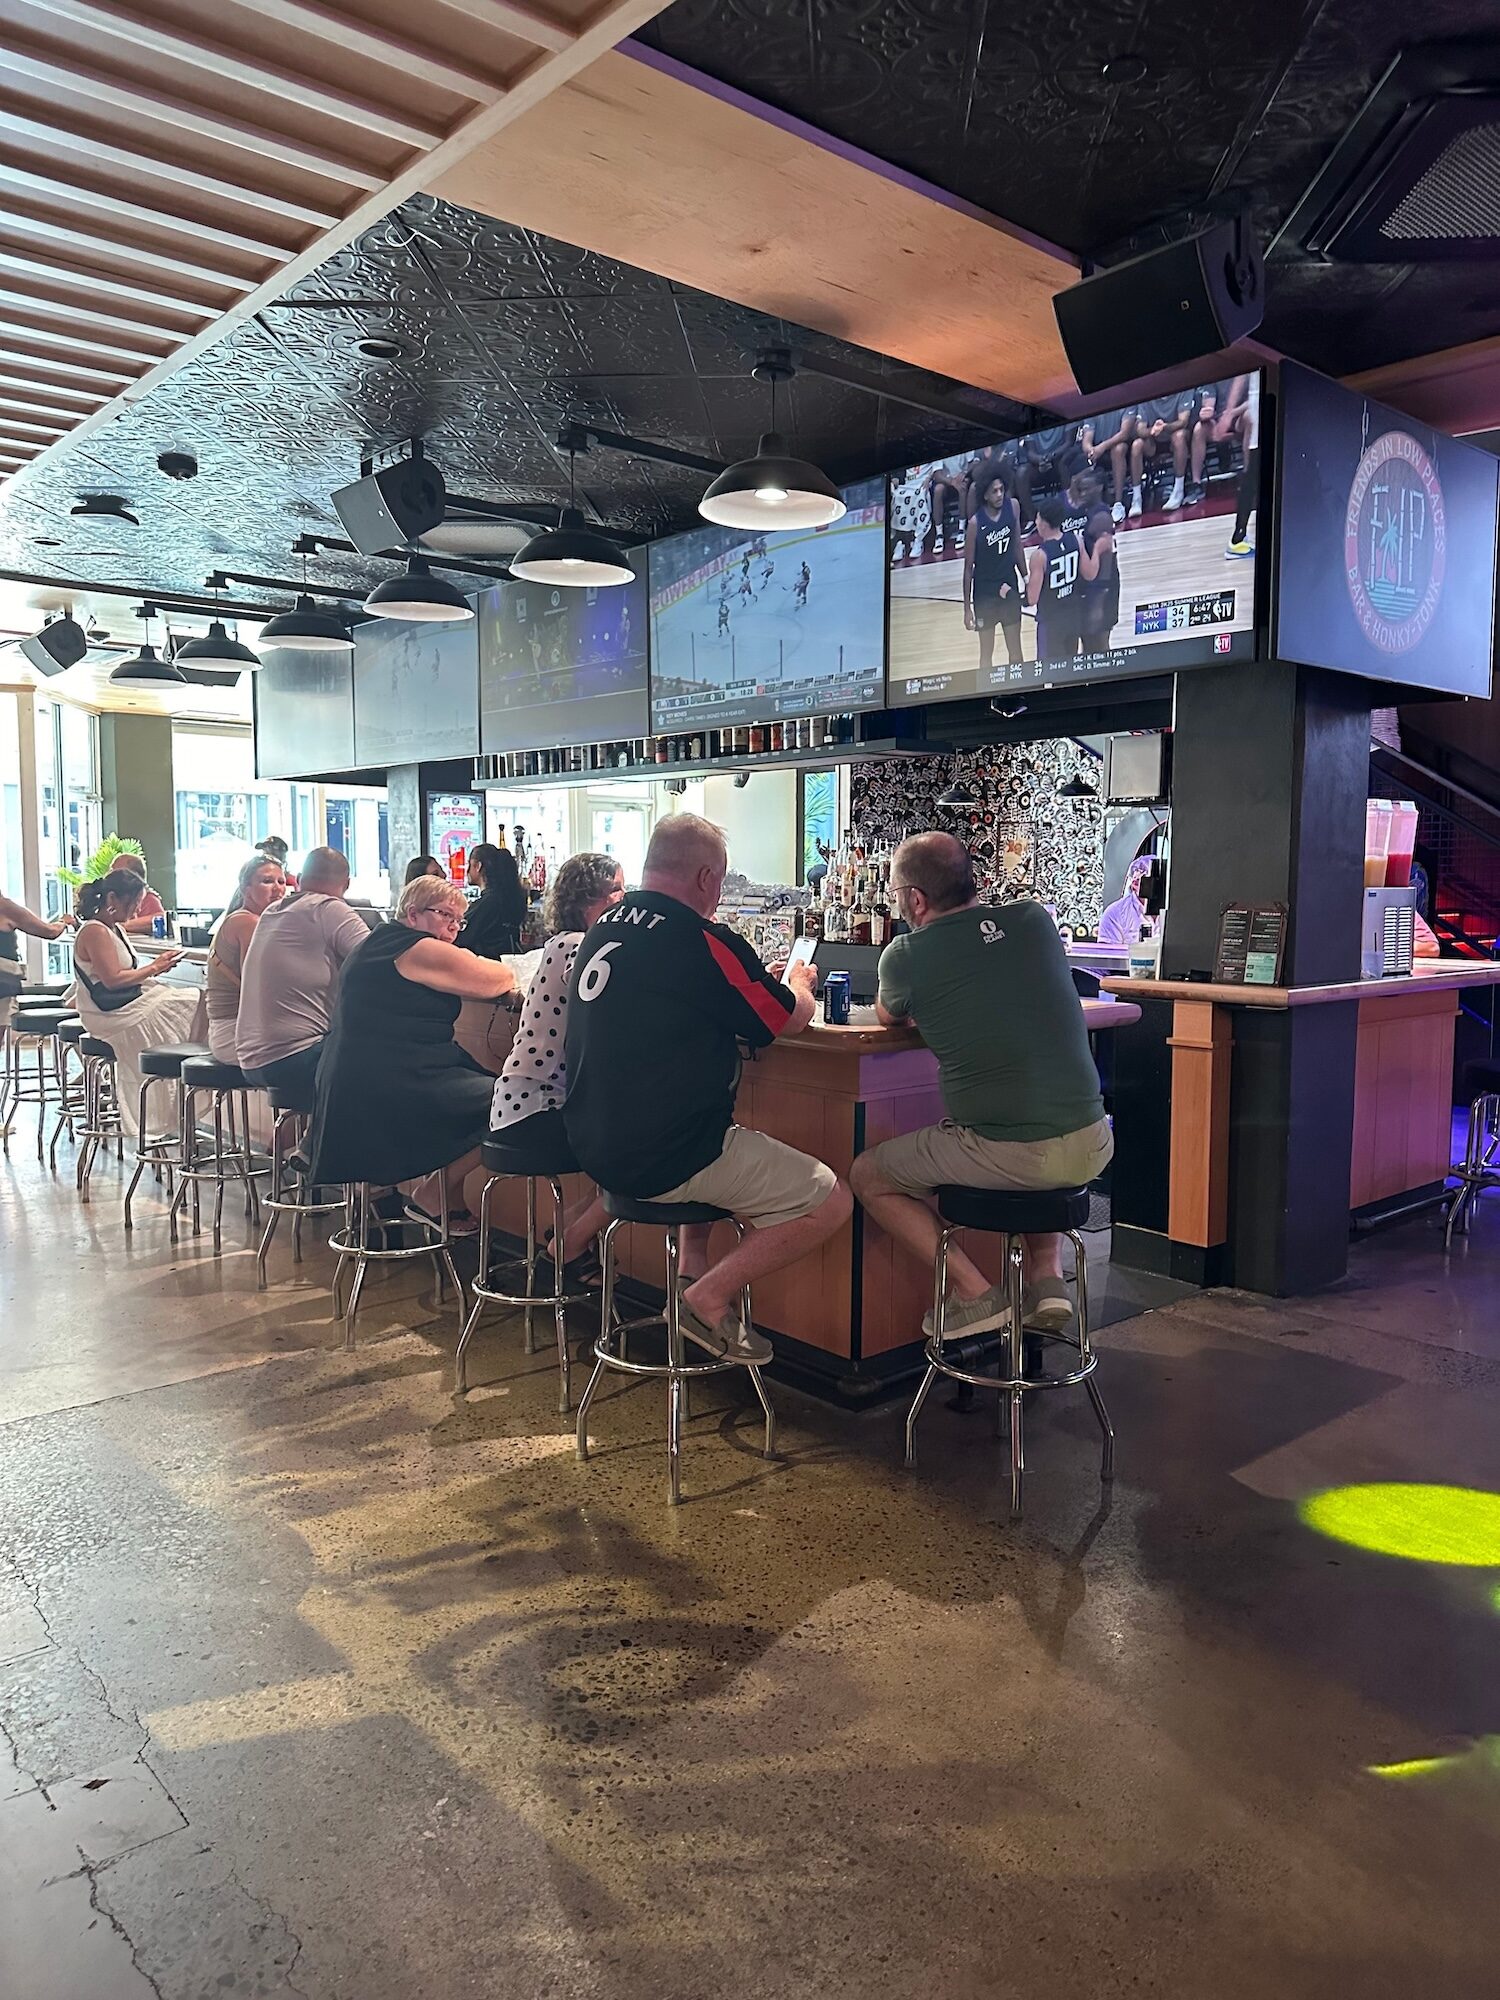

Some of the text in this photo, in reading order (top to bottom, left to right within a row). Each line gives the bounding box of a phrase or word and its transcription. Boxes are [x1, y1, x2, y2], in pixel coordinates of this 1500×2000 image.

[1347, 437, 1445, 554] FRIENDS IN LOW PLACES
[986, 526, 1010, 546] Kings
[998, 537, 1010, 554] 17
[1050, 550, 1079, 589] 20
[1199, 593, 1221, 601] LEAGUE
[1143, 602, 1232, 619] SAC 34 6:47 TV
[1349, 566, 1365, 614] BAR
[1372, 577, 1440, 648] HONKY-TONK
[1143, 621, 1160, 630] NYK
[1172, 618, 1184, 628] 37
[1221, 637, 1229, 649] TV
[1010, 663, 1022, 672] SAC
[1010, 671, 1022, 680] NYK
[597, 905, 666, 929] KENT
[578, 941, 622, 1001] 6
